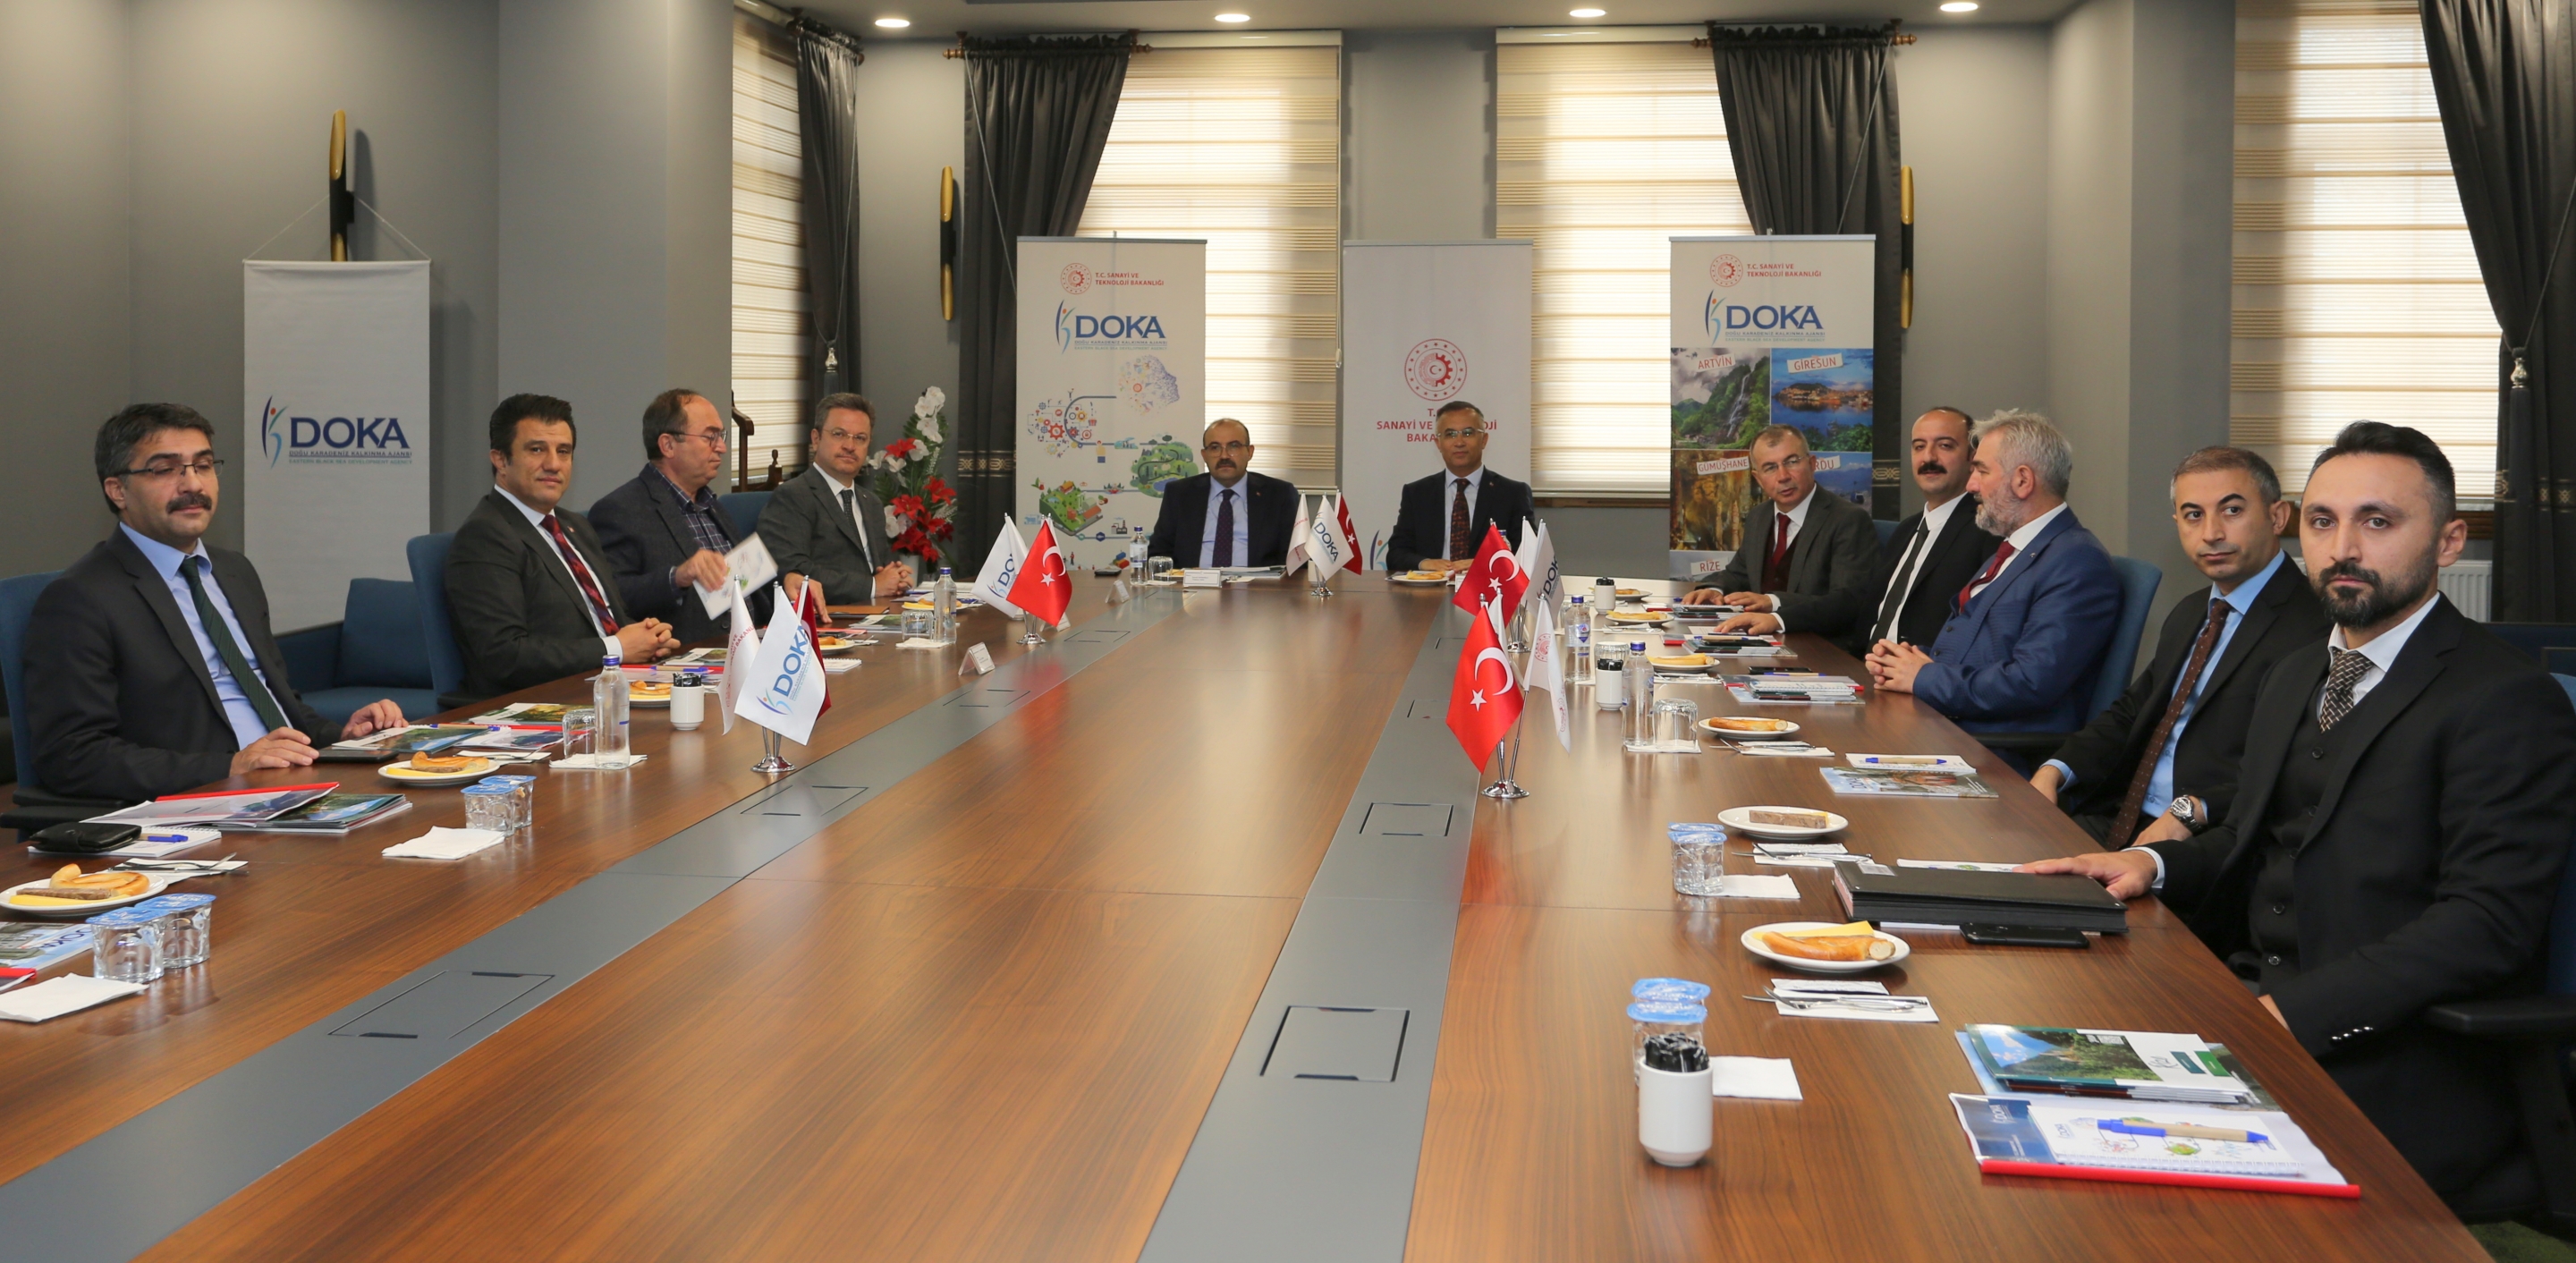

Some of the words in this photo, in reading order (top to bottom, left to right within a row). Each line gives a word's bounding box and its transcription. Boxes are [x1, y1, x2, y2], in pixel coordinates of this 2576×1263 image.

[1075, 315, 1166, 338] DOKA
[1725, 305, 1824, 329] DOKA
[1698, 355, 1733, 370] ARTVİN
[1793, 356, 1837, 371] GİRESUN
[290, 417, 411, 449] DOKA
[1377, 419, 1416, 430] SANAYİ
[1419, 420, 1433, 429] VE
[1698, 458, 1749, 473] GÜMÜŞHANE
[1815, 459, 1835, 470] RDU
[1313, 521, 1339, 562] DOKA
[997, 554, 1015, 587] DO
[1543, 555, 1559, 596] DOK
[1699, 560, 1721, 572] RİZE
[773, 624, 809, 698] DOKA
